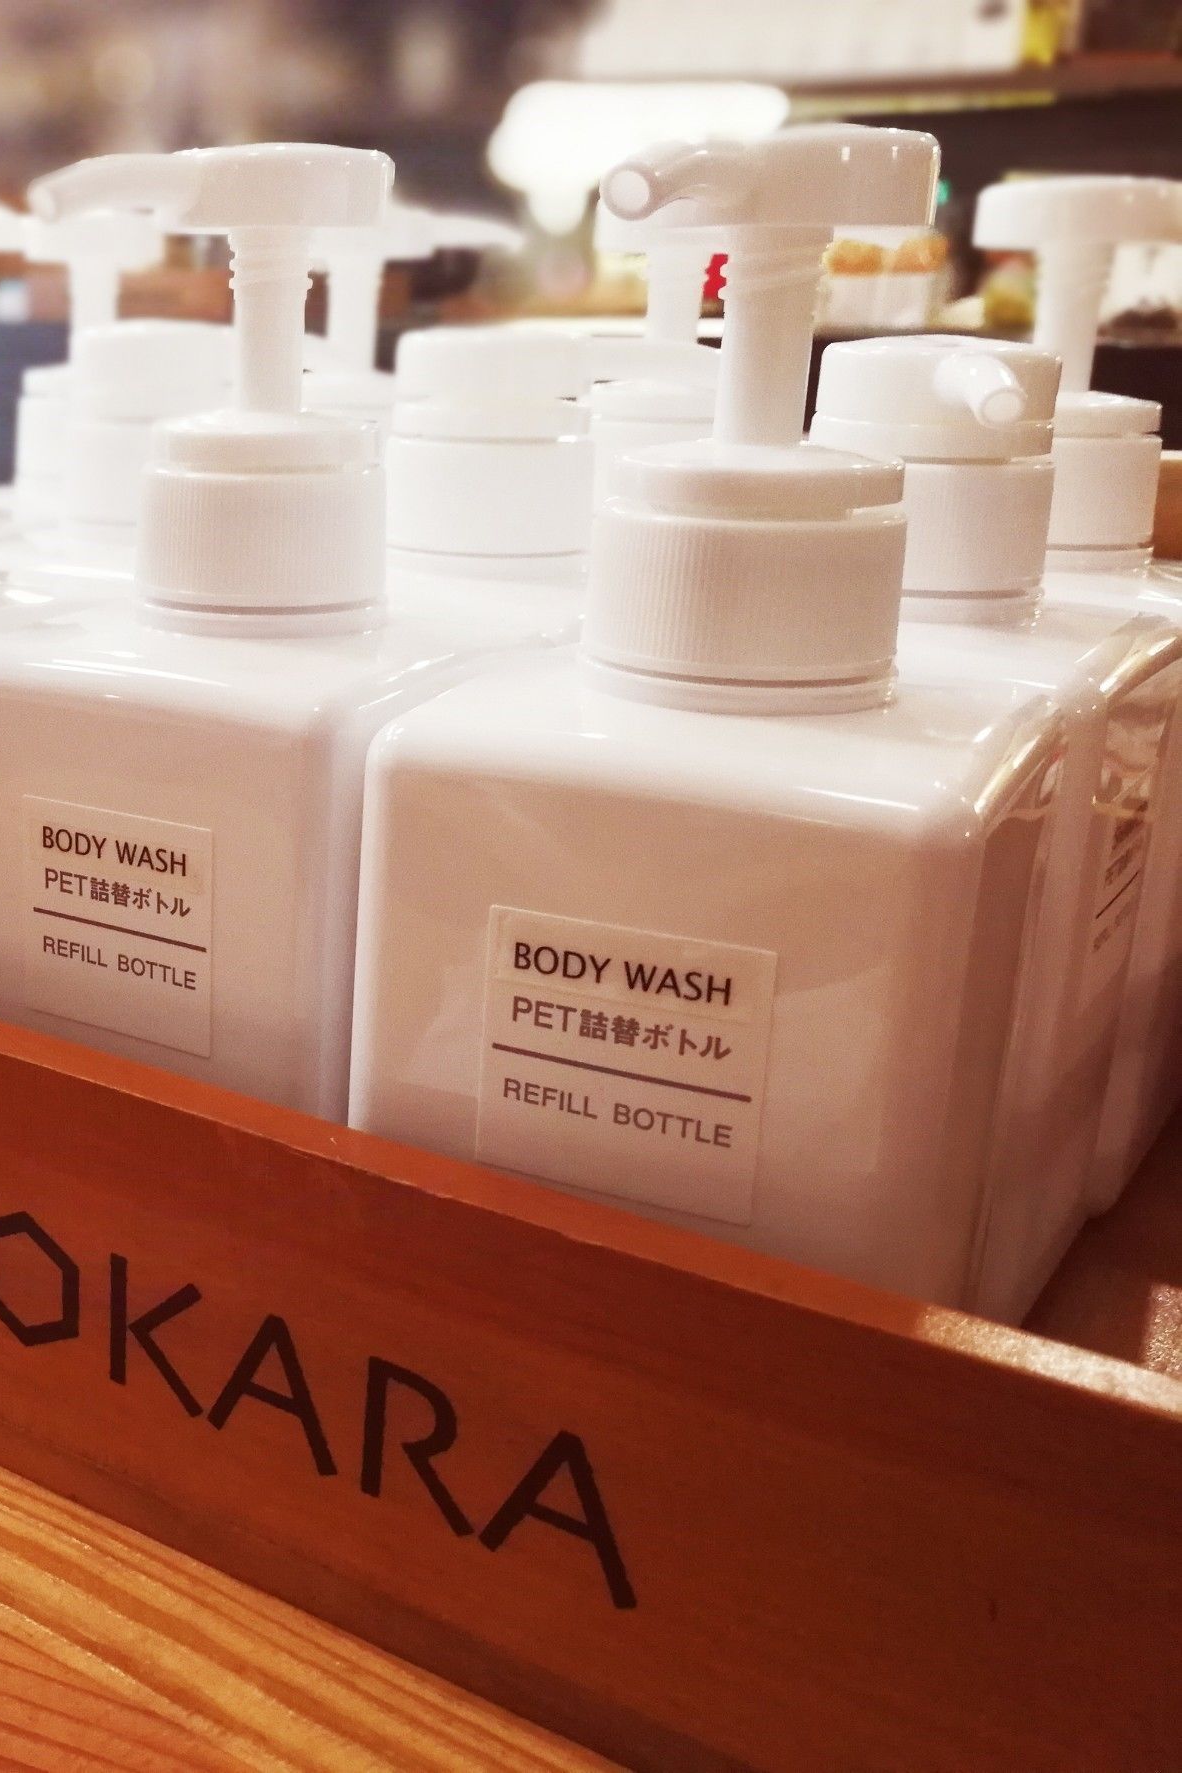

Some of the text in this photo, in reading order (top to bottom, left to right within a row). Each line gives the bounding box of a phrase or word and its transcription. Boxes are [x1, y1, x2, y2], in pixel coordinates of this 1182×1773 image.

[41, 825, 188, 877] BODY WASH
[44, 867, 191, 918] PET詰替ボトル
[42, 935, 197, 991] REFILL BOTTLE
[513, 941, 732, 1007] BODY WASH
[511, 995, 732, 1061] PET詰替ボトル
[502, 1077, 733, 1149] REFILL BOTTLE
